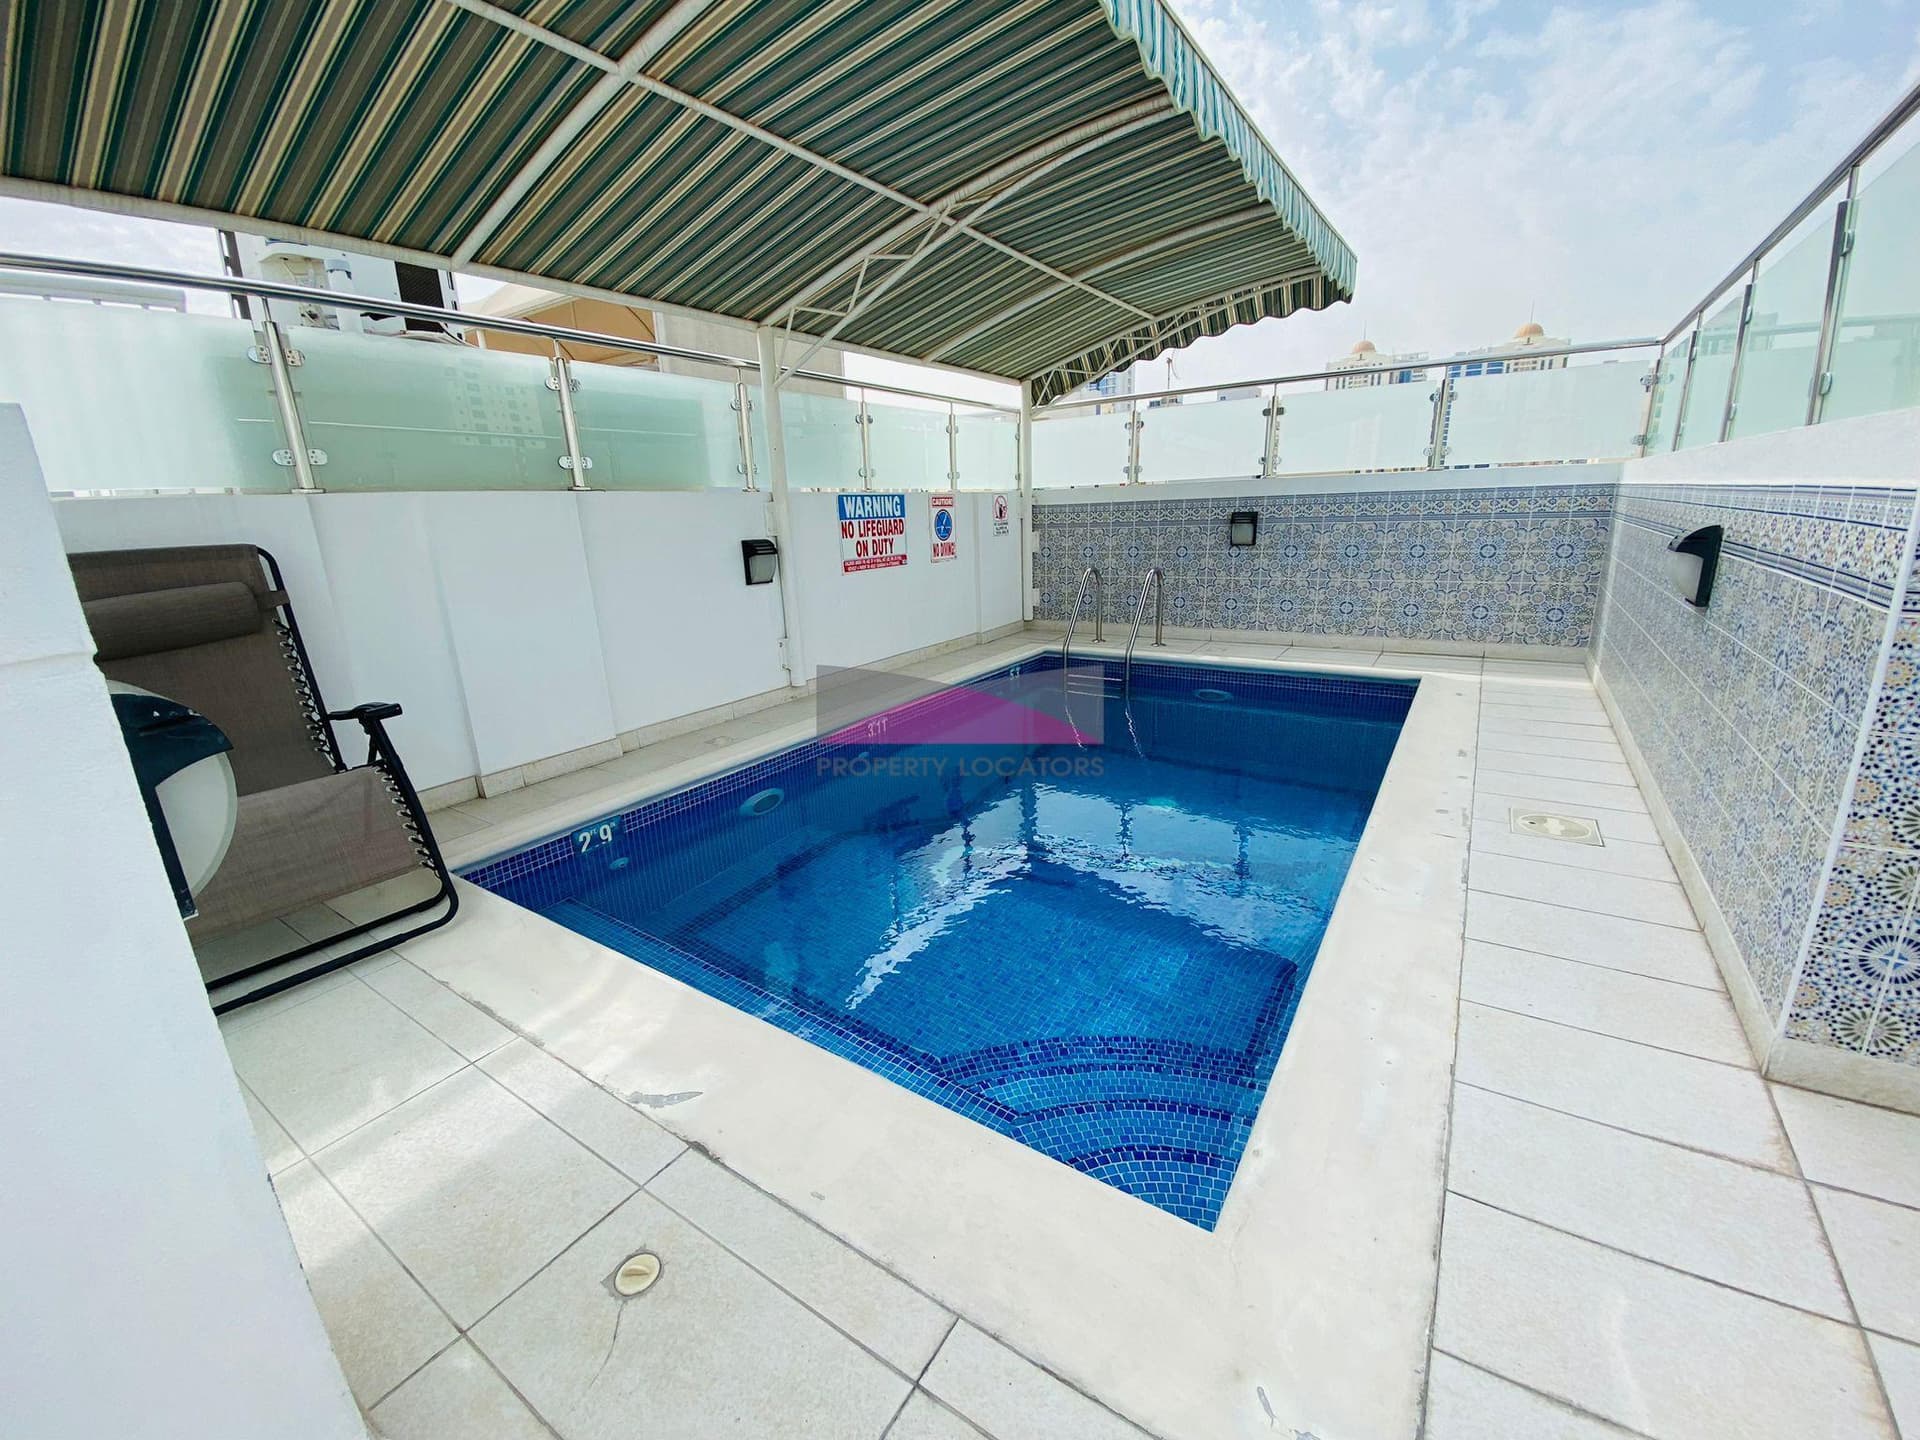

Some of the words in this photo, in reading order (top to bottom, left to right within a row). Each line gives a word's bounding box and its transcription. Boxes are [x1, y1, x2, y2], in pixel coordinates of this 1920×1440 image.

[843, 495, 901, 518] WARNING
[841, 520, 855, 539] NO
[858, 518, 905, 538] LIFEGUARD
[855, 539, 869, 557] ON
[872, 537, 894, 556] DUTY
[932, 543, 940, 557] NO
